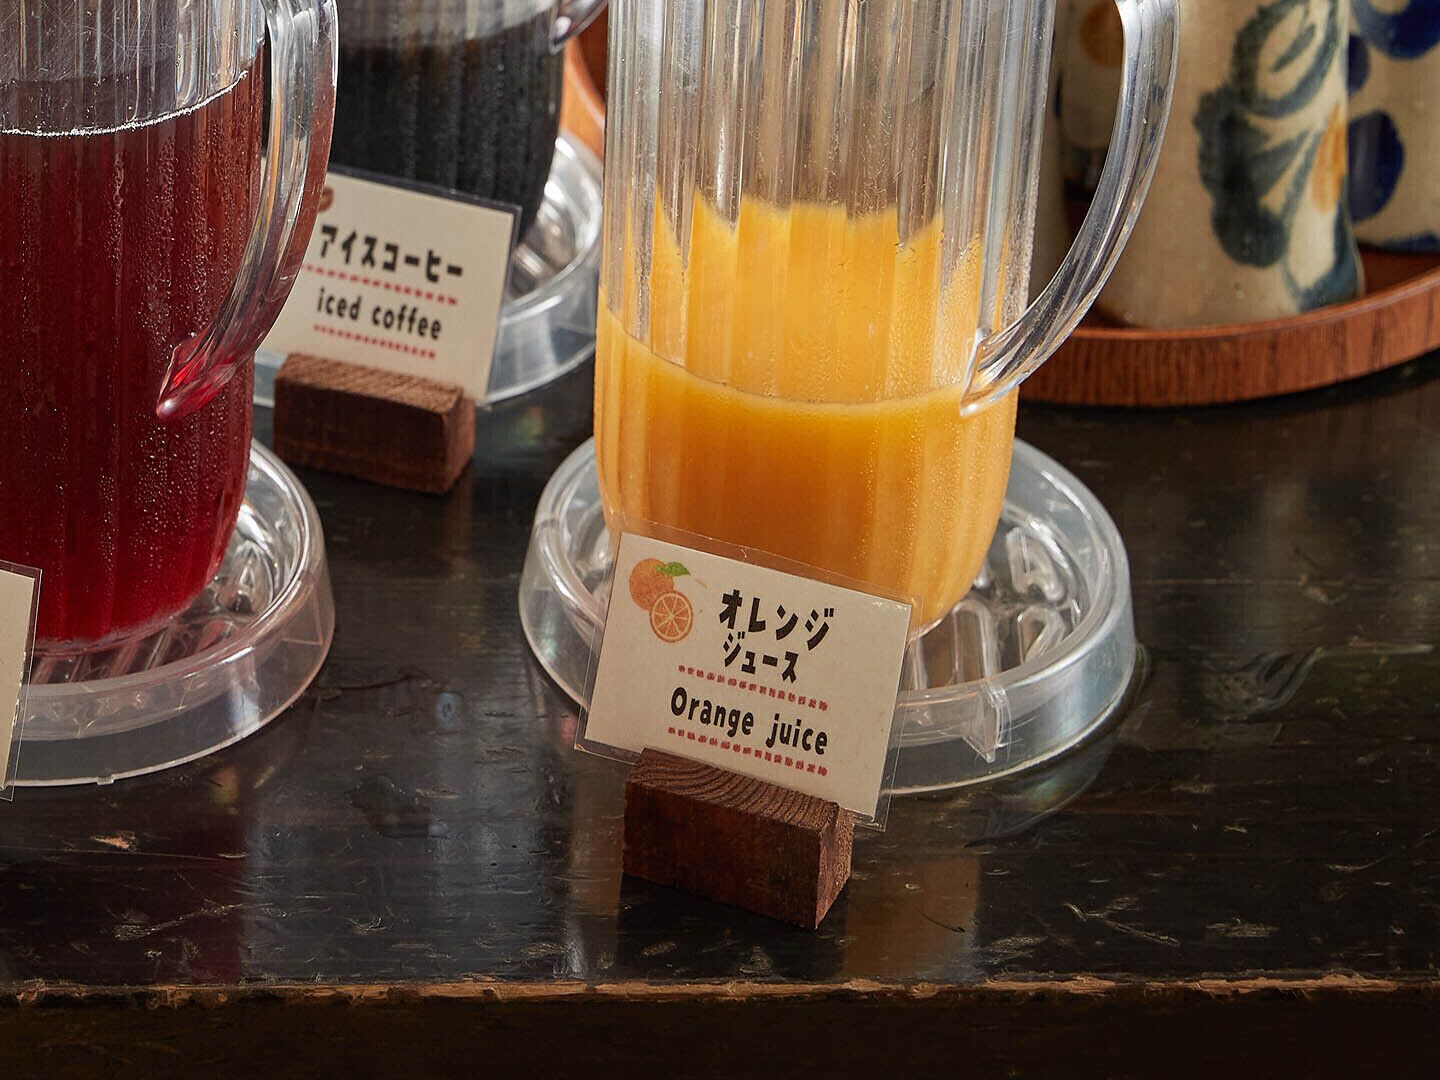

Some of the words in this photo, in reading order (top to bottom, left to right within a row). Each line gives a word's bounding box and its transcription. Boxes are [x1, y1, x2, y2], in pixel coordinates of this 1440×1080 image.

[321, 224, 463, 283] アイスコーヒー
[317, 288, 361, 321] iced
[371, 305, 442, 341] coffee
[719, 589, 835, 651] オレンジ
[723, 631, 799, 684] ジュース
[670, 686, 754, 738] Orange
[765, 713, 828, 755] juice
